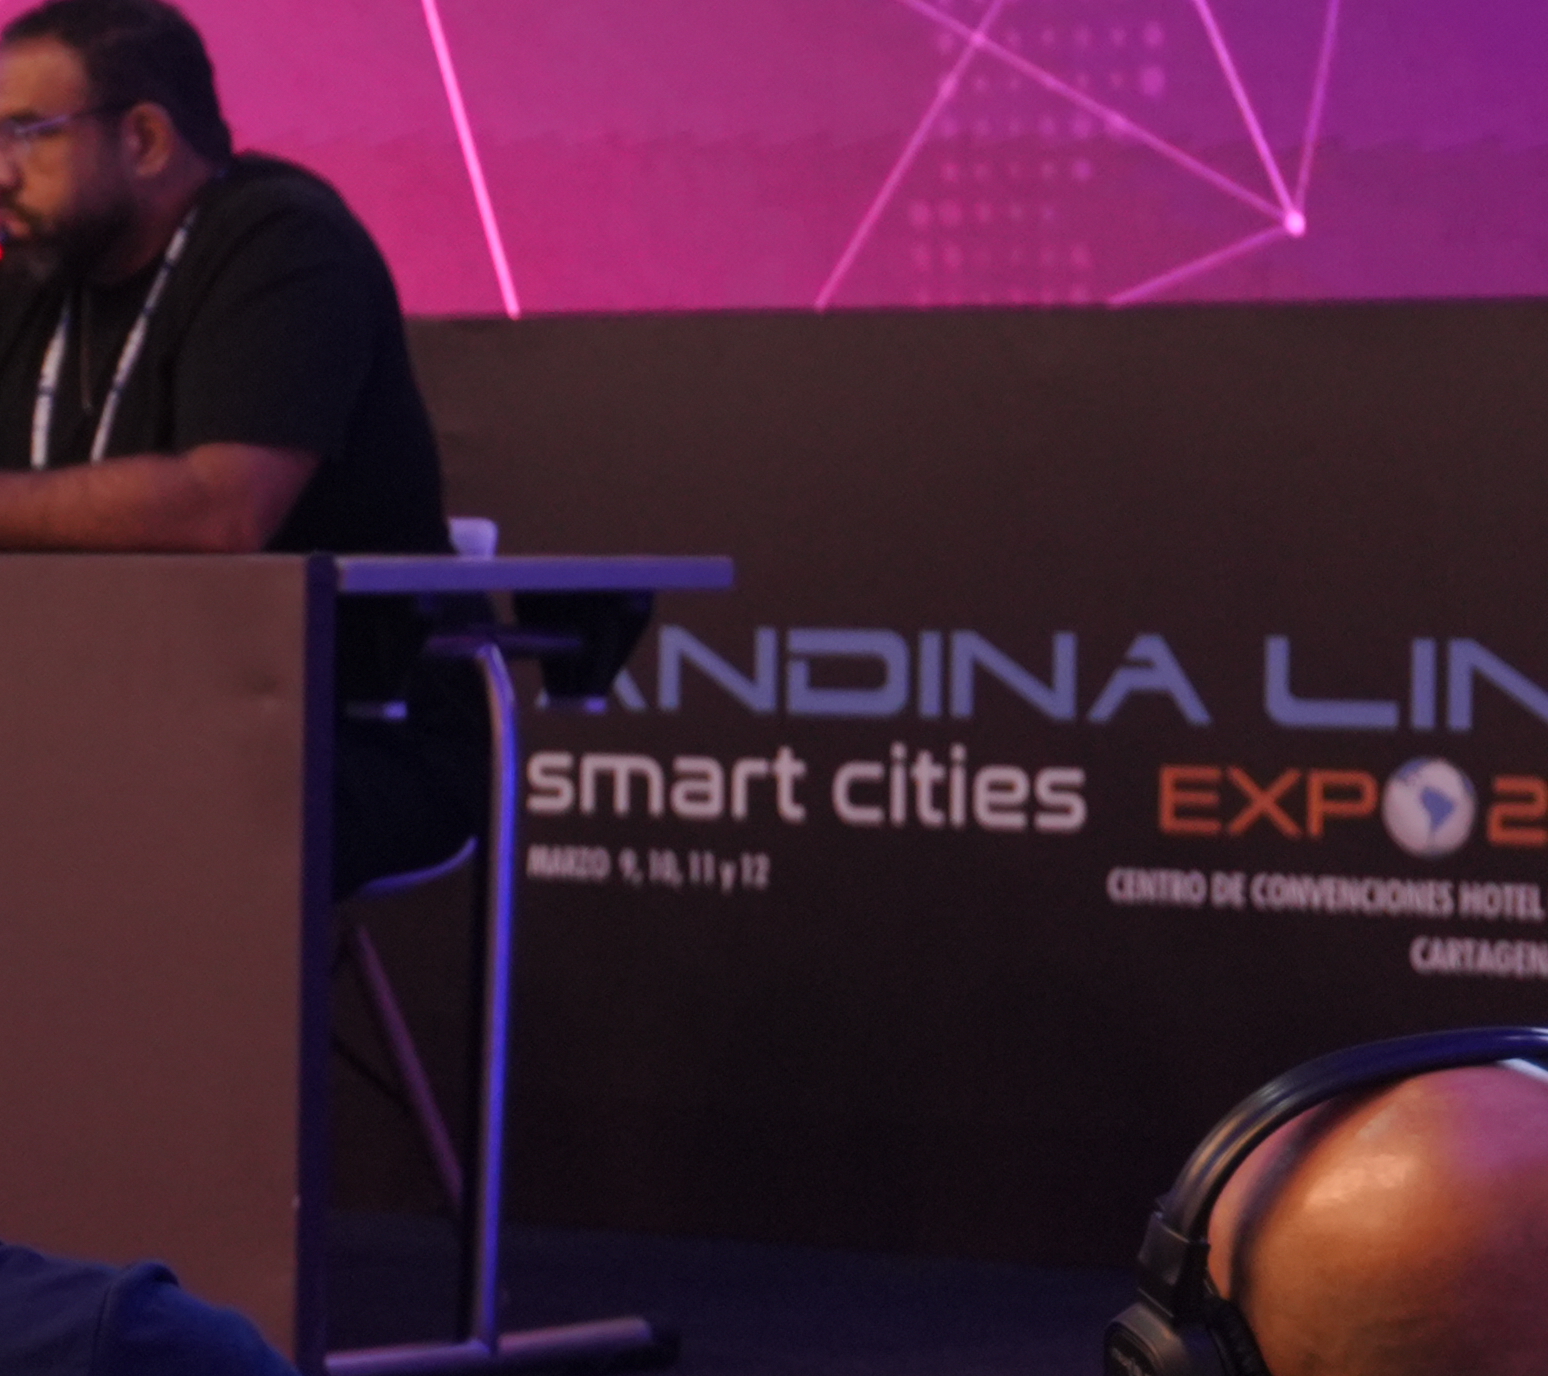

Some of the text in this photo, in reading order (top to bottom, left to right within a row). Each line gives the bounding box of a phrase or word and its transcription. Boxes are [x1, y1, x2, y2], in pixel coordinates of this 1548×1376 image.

[534, 625, 1548, 732] NDINA LIN
[526, 742, 1089, 833] smart cities
[1106, 864, 1546, 922] CENTRO DE CONVENCIONES HOTEL
[1408, 934, 1548, 980] CARTAGEN
